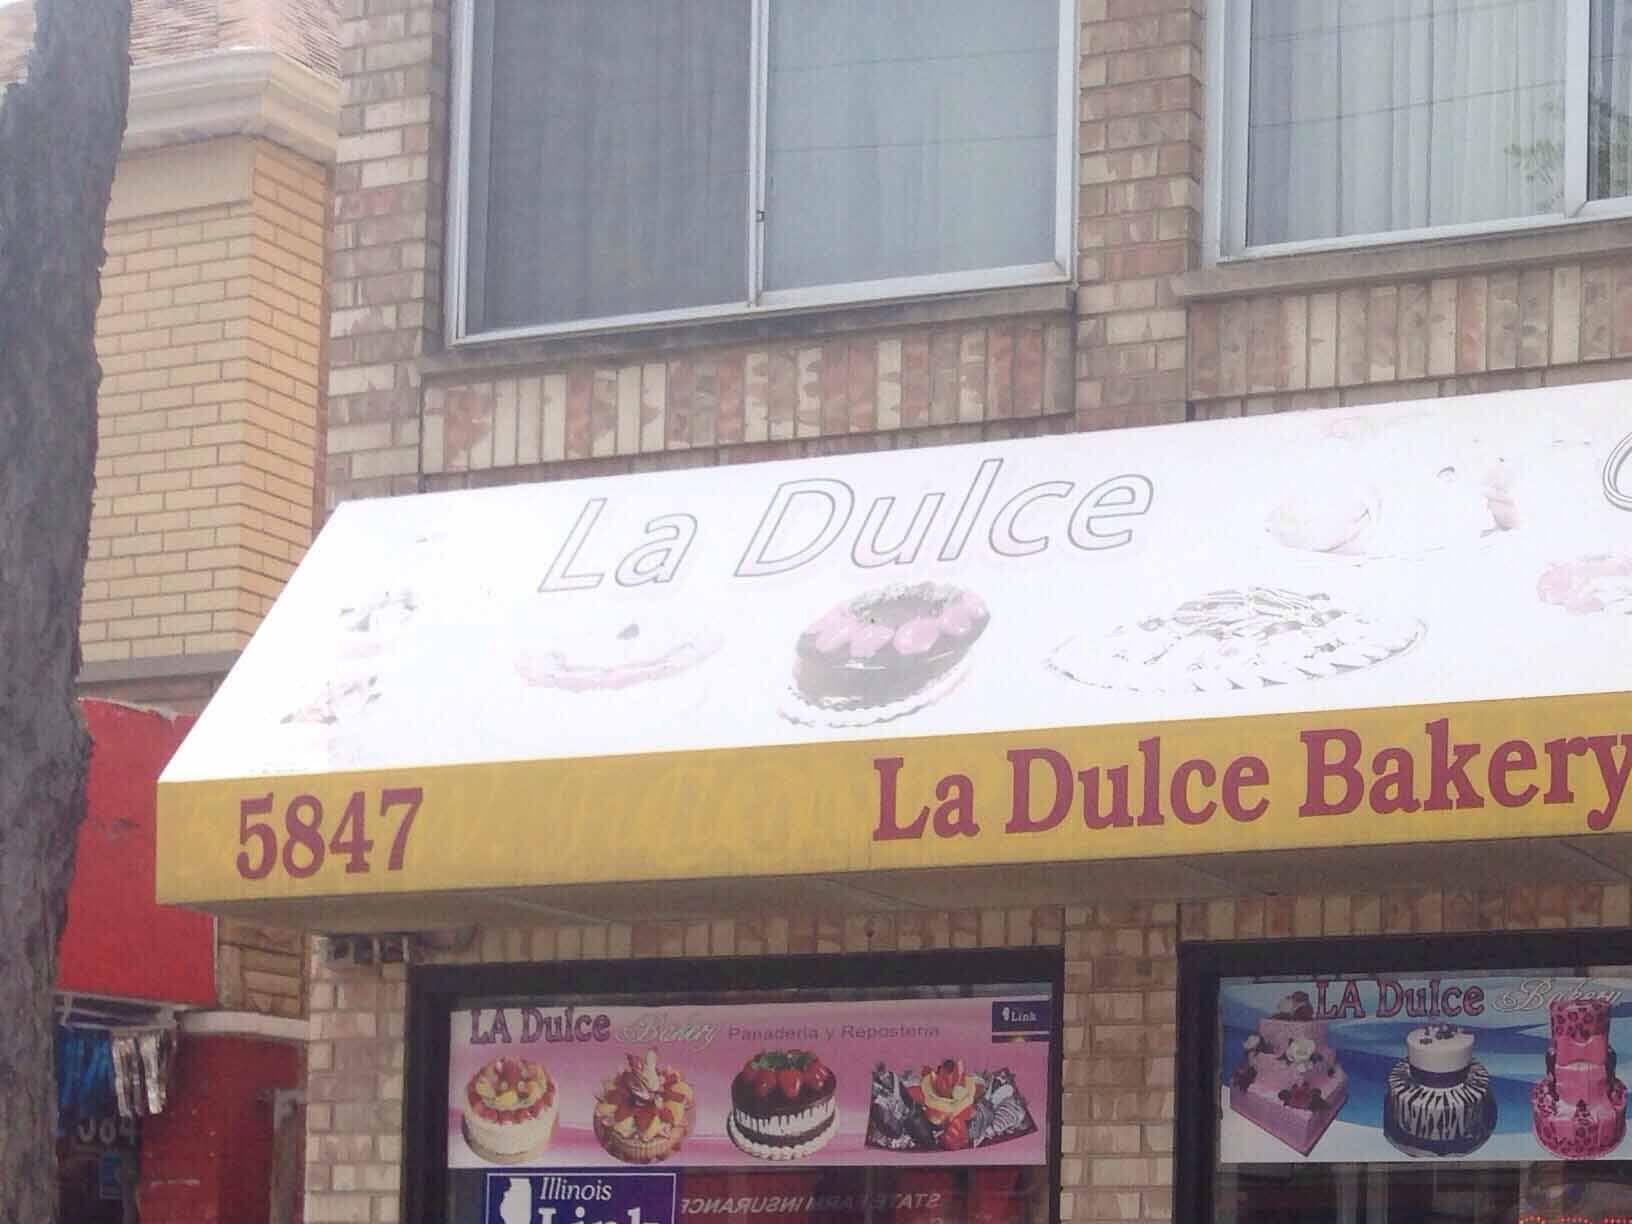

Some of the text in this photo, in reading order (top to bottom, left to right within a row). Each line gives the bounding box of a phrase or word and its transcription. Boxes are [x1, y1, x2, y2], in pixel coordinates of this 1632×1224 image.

[538, 497, 698, 592] La
[734, 458, 1154, 579] Dulce
[235, 787, 424, 881] 5847
[872, 756, 979, 842] La
[1005, 736, 1270, 834] Dulce
[1315, 976, 1625, 1019] LA Dulce Bakery
[470, 1006, 513, 1045] LA
[520, 1005, 611, 1043] Dulce
[539, 1176, 613, 1201] Illinois
